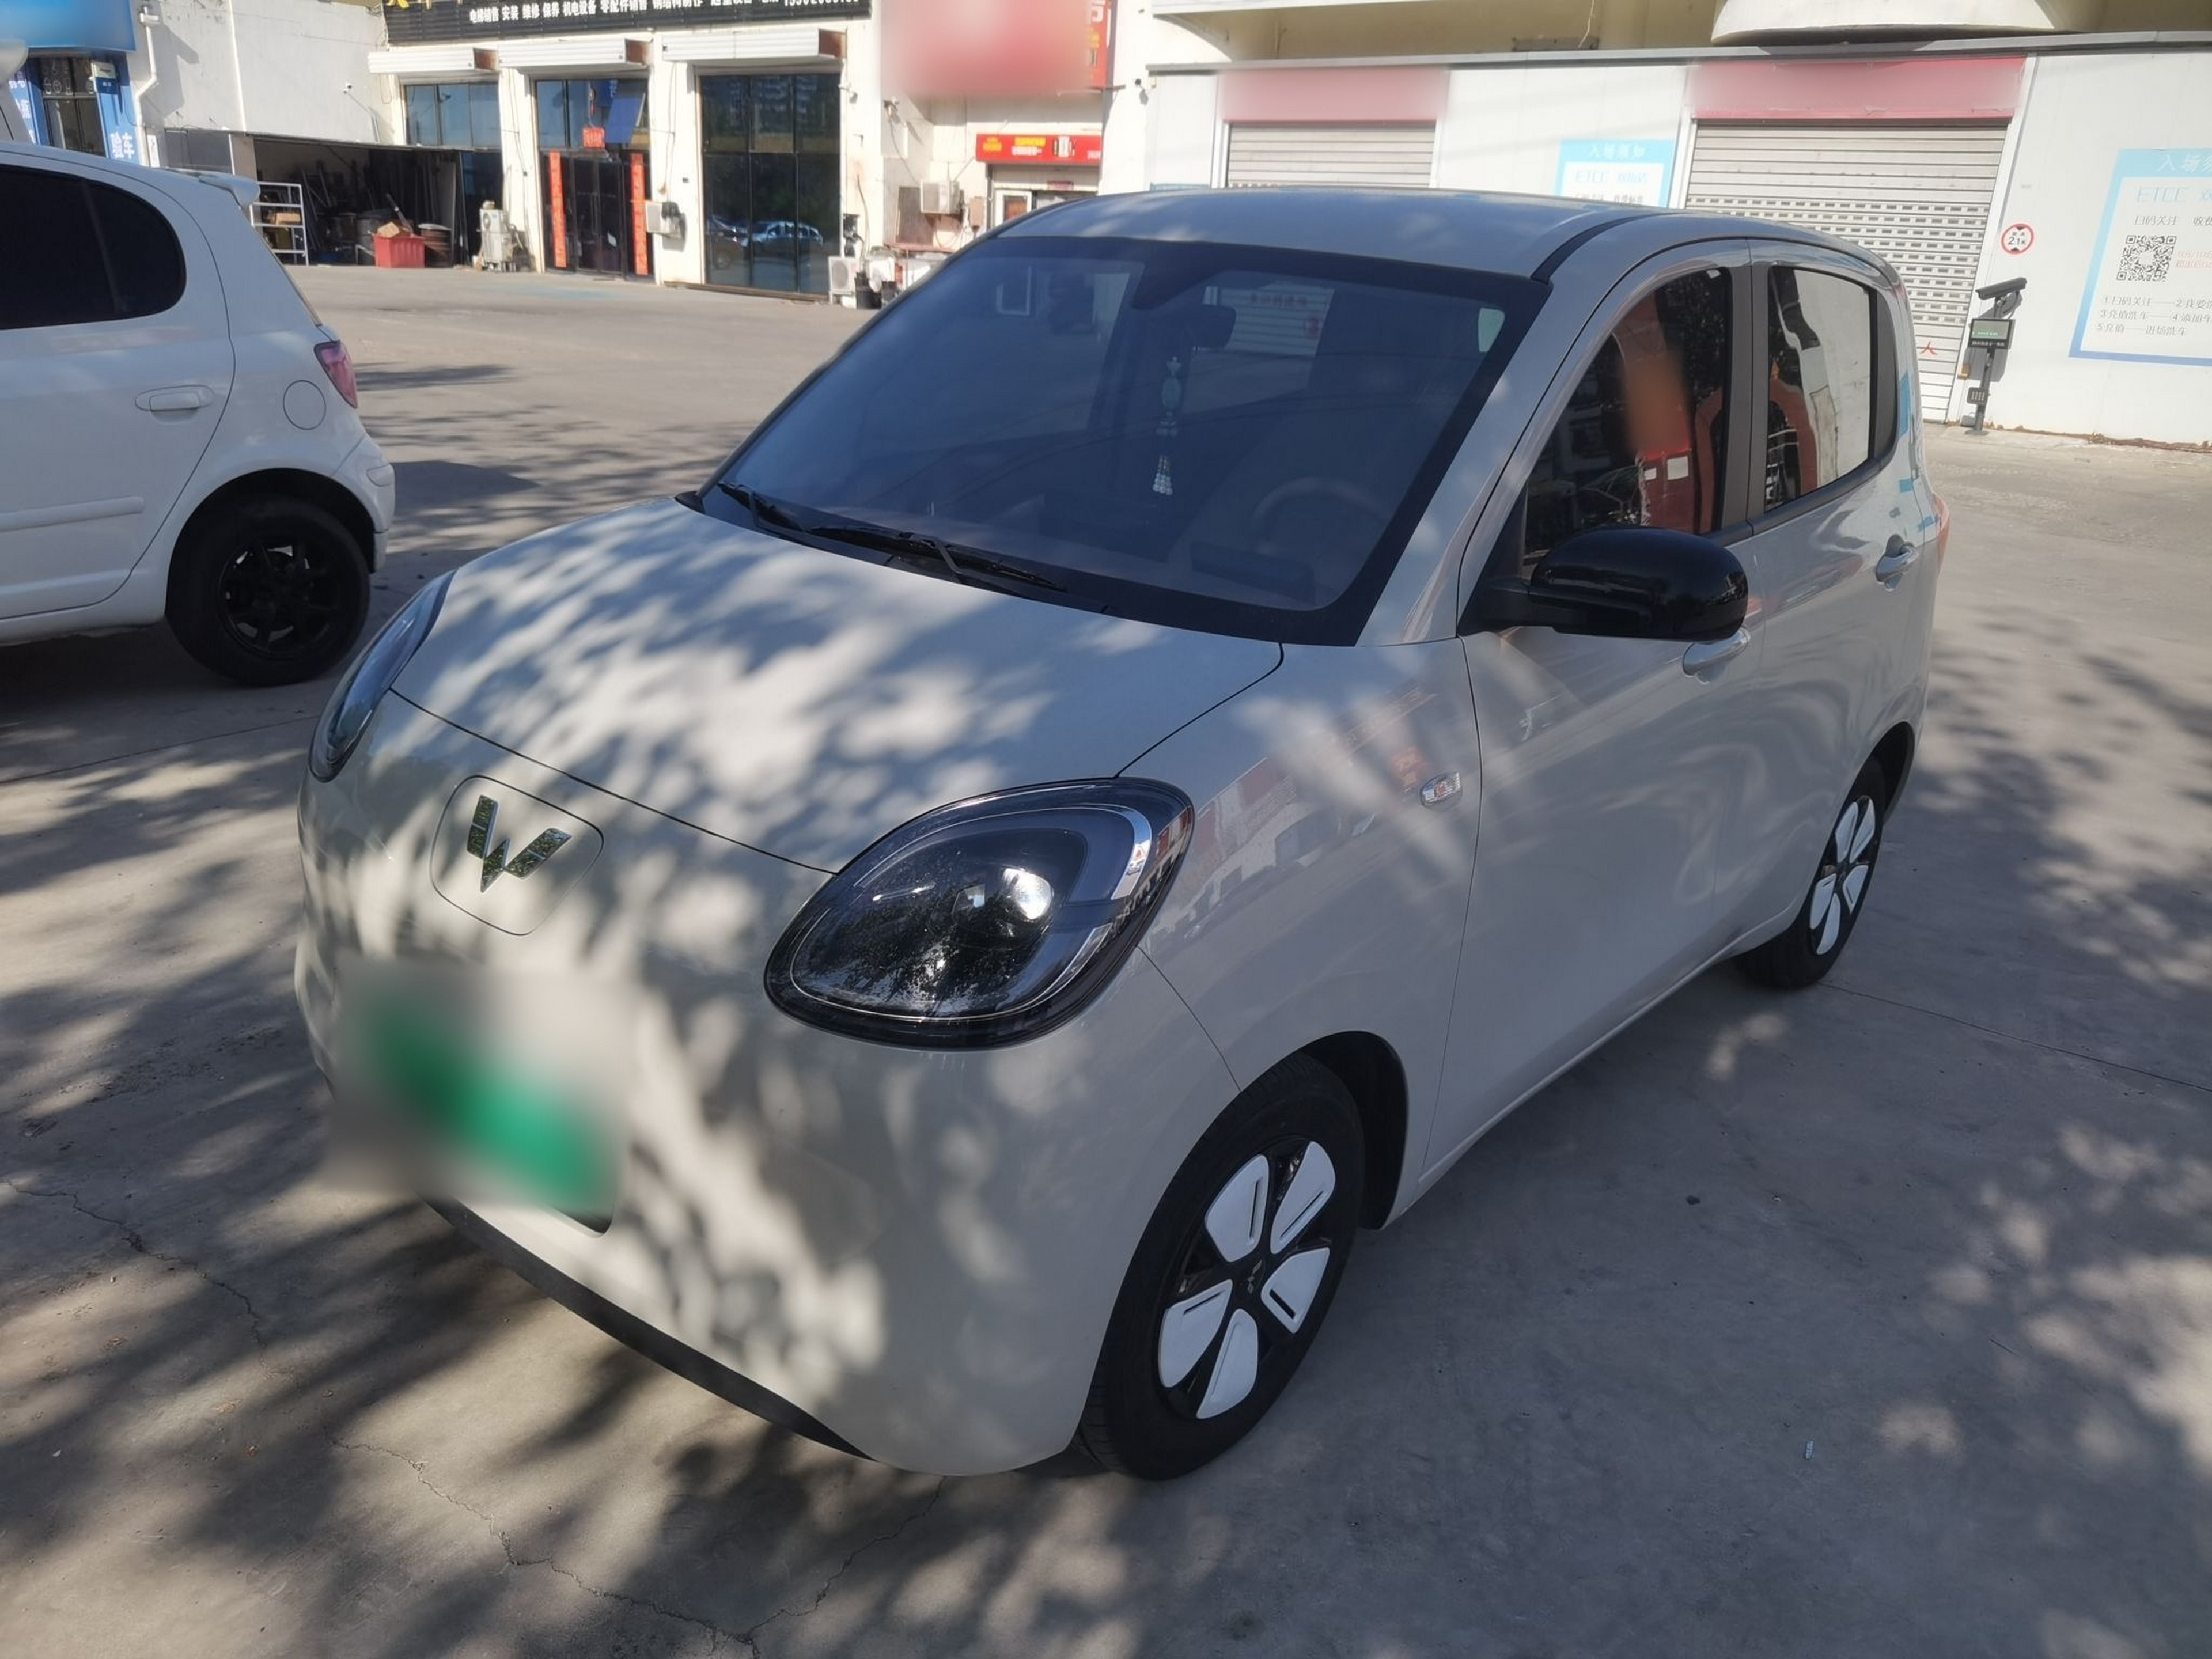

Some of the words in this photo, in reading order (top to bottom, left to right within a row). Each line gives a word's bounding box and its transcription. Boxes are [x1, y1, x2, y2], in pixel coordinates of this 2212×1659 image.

[502, 5, 519, 21] 安装
[543, 2, 560, 18] 保养
[110, 132, 135, 160] 验车
